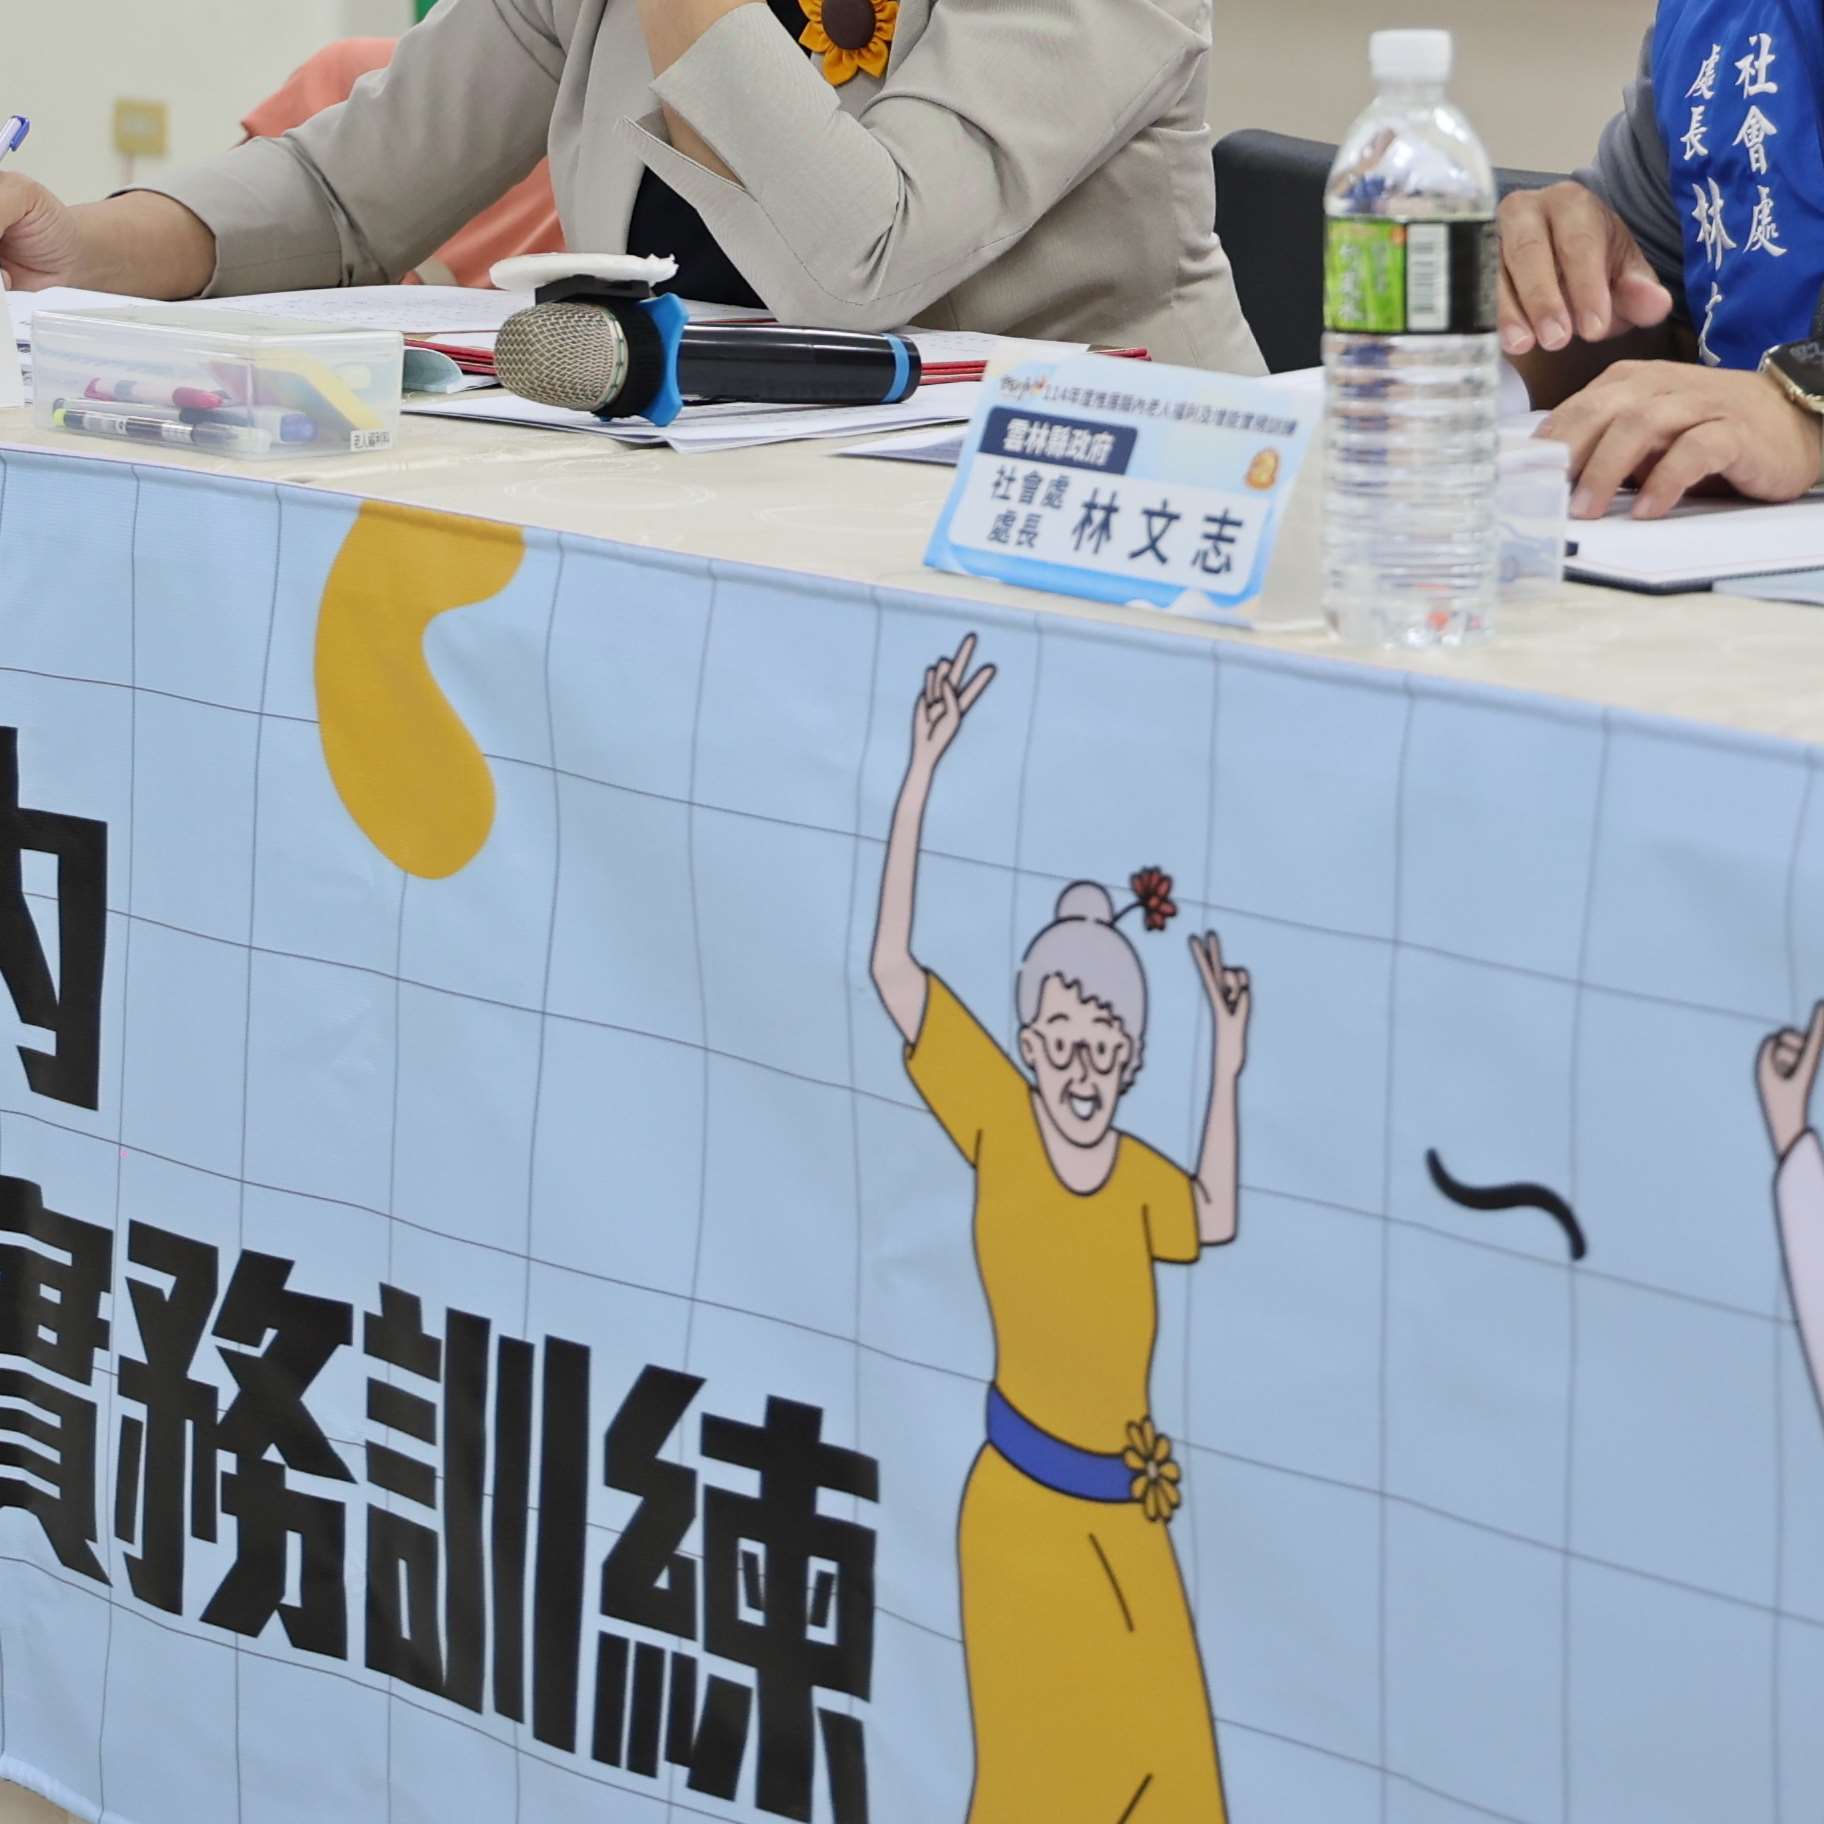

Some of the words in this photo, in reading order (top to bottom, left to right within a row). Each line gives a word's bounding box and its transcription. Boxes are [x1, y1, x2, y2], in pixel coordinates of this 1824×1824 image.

[1732, 33, 1787, 256] 社會處
[1002, 418, 1116, 466] 雲林縣政府
[990, 465, 1070, 510] 社會處
[987, 509, 1043, 549] 處長
[1073, 487, 1243, 575] 林文志
